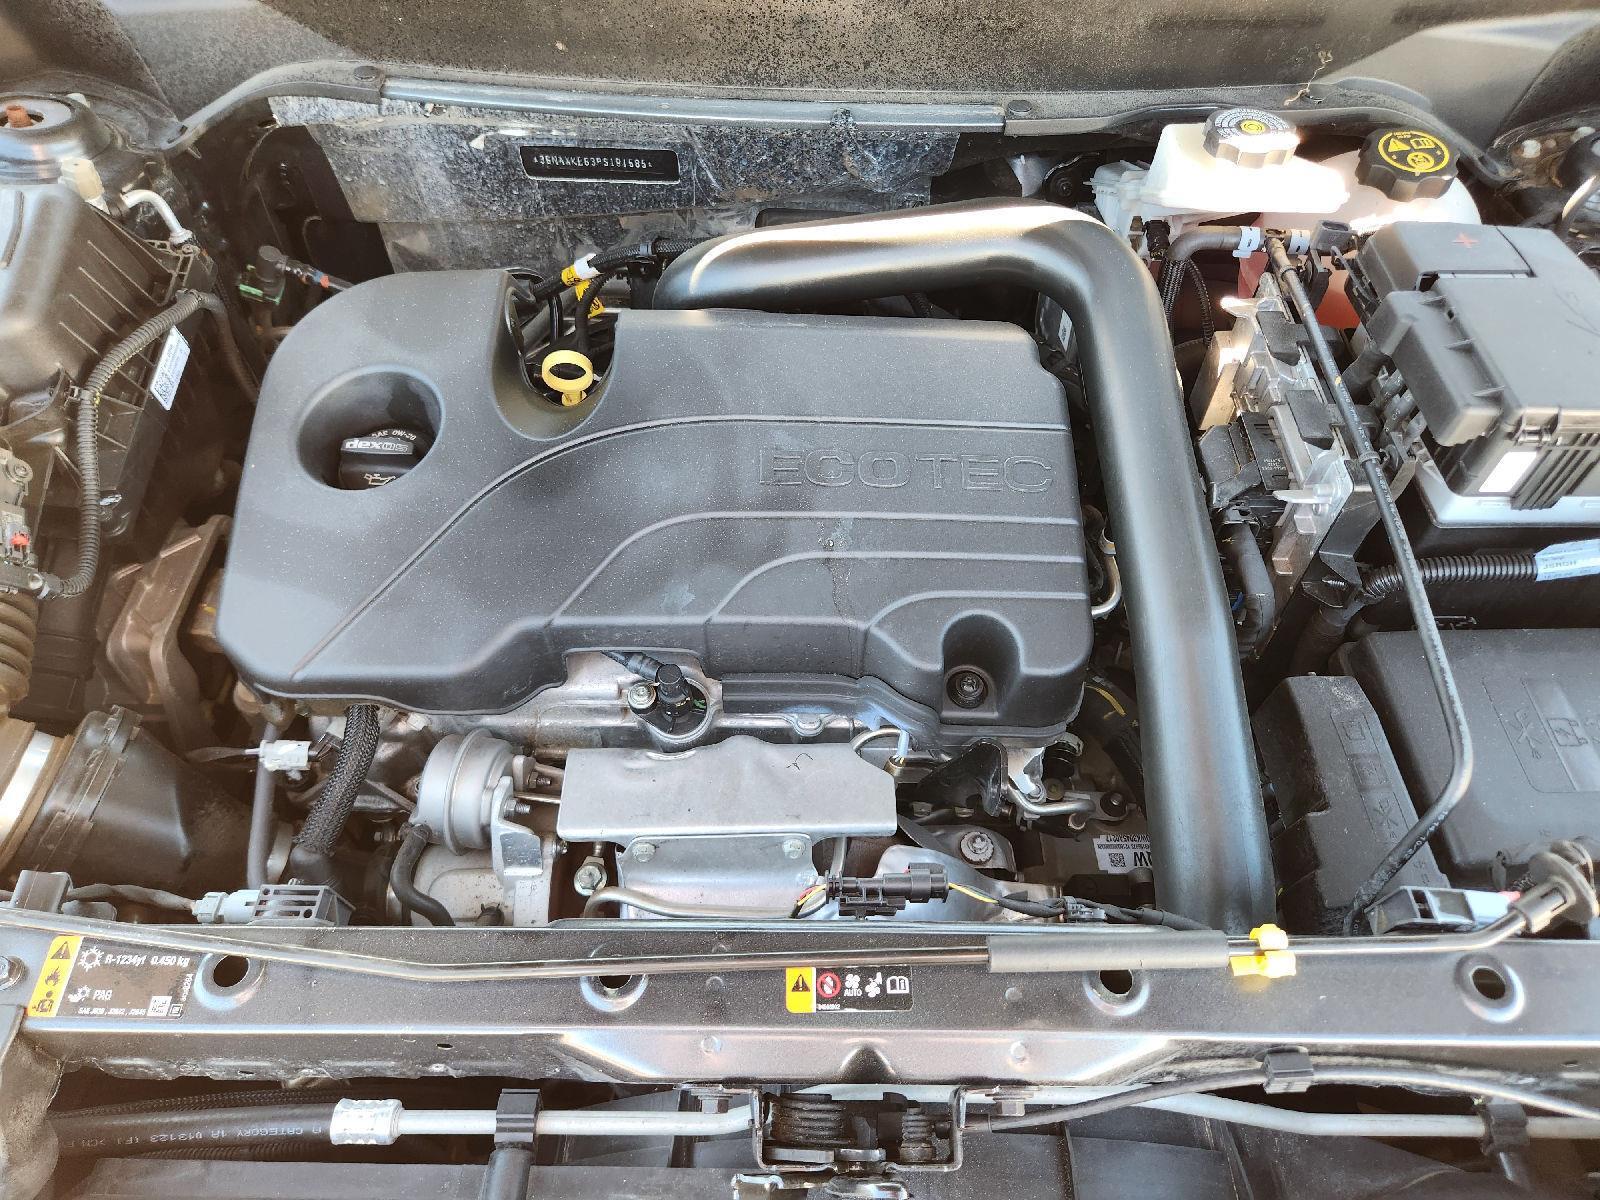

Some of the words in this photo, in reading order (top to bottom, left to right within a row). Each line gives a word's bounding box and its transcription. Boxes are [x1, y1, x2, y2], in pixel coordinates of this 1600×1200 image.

[345, 437, 409, 453] dexos
[759, 449, 1052, 492] ECOTEC
[104, 954, 147, 967] R-1234yf
[151, 955, 177, 966] 0.450
[177, 955, 190, 968] kg
[93, 989, 113, 1001] PAG
[843, 988, 863, 997] AUTO
[211, 1130, 225, 1139] 1A
[237, 1127, 304, 1137] CATEGORY
